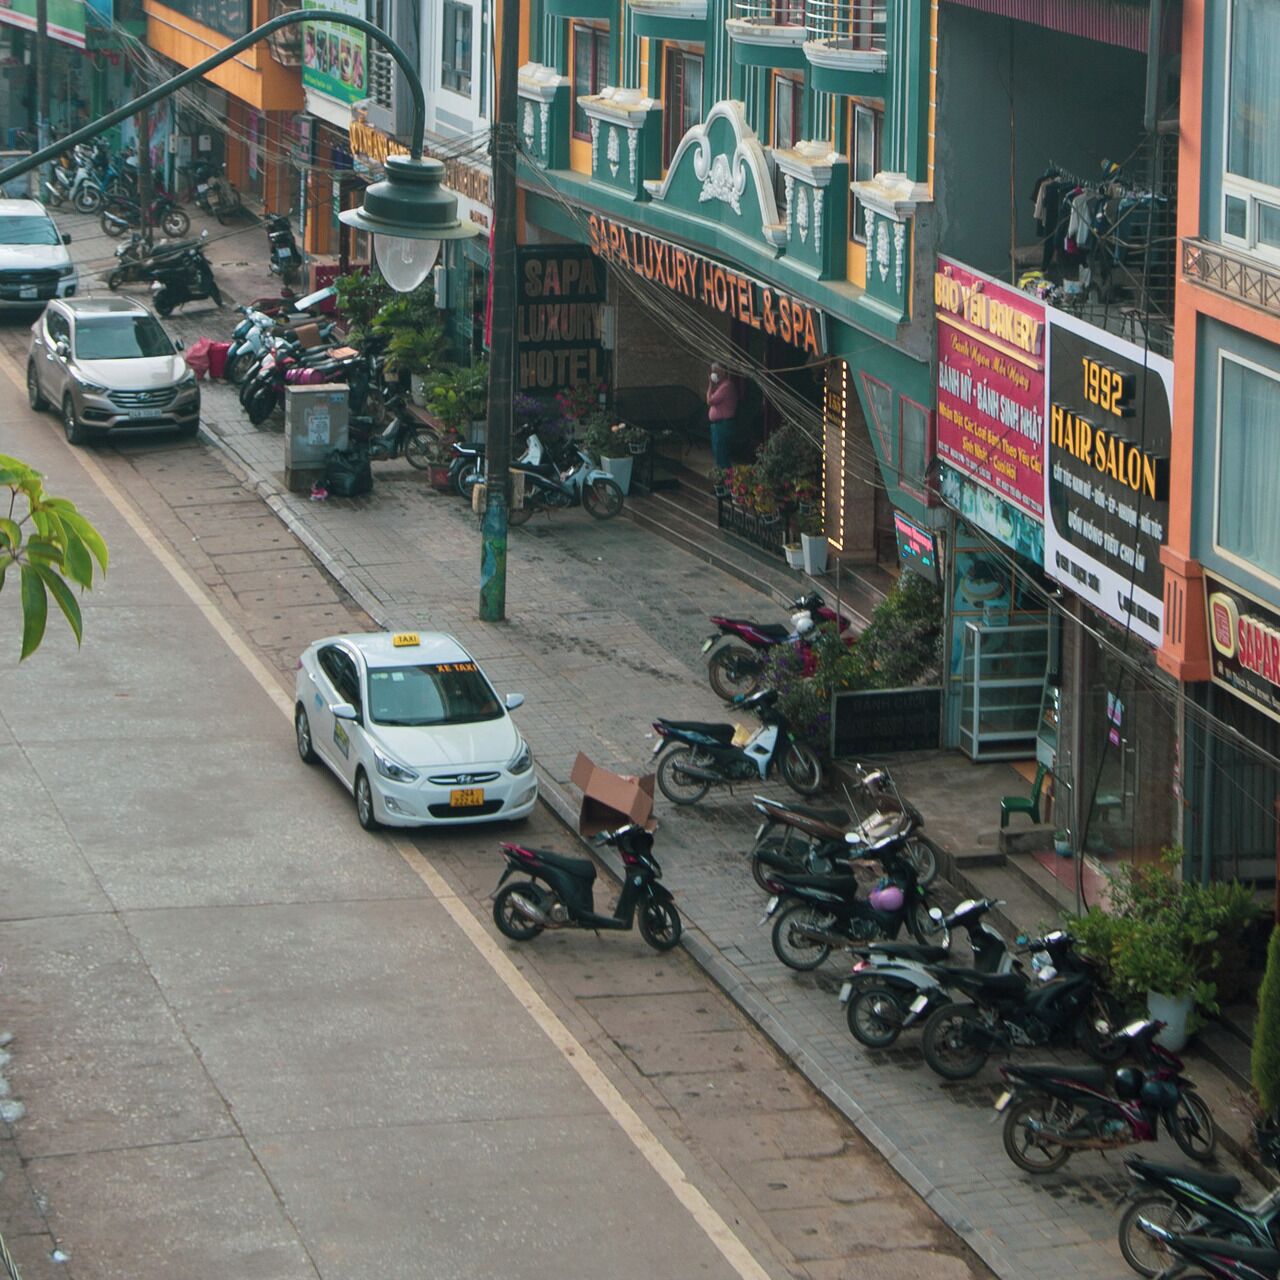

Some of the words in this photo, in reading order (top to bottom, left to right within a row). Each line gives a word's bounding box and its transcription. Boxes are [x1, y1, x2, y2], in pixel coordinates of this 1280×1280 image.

[524, 258, 597, 297] SAPA
[589, 214, 631, 270] SAPA
[631, 230, 699, 300] LUXURY
[701, 262, 761, 327] HOTEL
[761, 288, 777, 336] &
[778, 294, 820, 357] SPA
[518, 303, 604, 342] LUXURY
[934, 265, 962, 314] BẢO
[989, 299, 1040, 355] BAKERY
[519, 348, 604, 390] HOTEL
[1081, 357, 1123, 417] 1992
[939, 355, 960, 399] BÁNH
[977, 378, 999, 421] BÁNH
[1000, 395, 1019, 432] SINH
[1020, 405, 1043, 451] NHẬT
[1001, 437, 1017, 458] Theo
[1051, 404, 1092, 466] HAIR
[1094, 428, 1156, 501] SALON
[1083, 519, 1104, 548] NÓNG
[397, 634, 418, 644] TAXI
[435, 664, 452, 673] XE
[453, 663, 477, 673] TAXI
